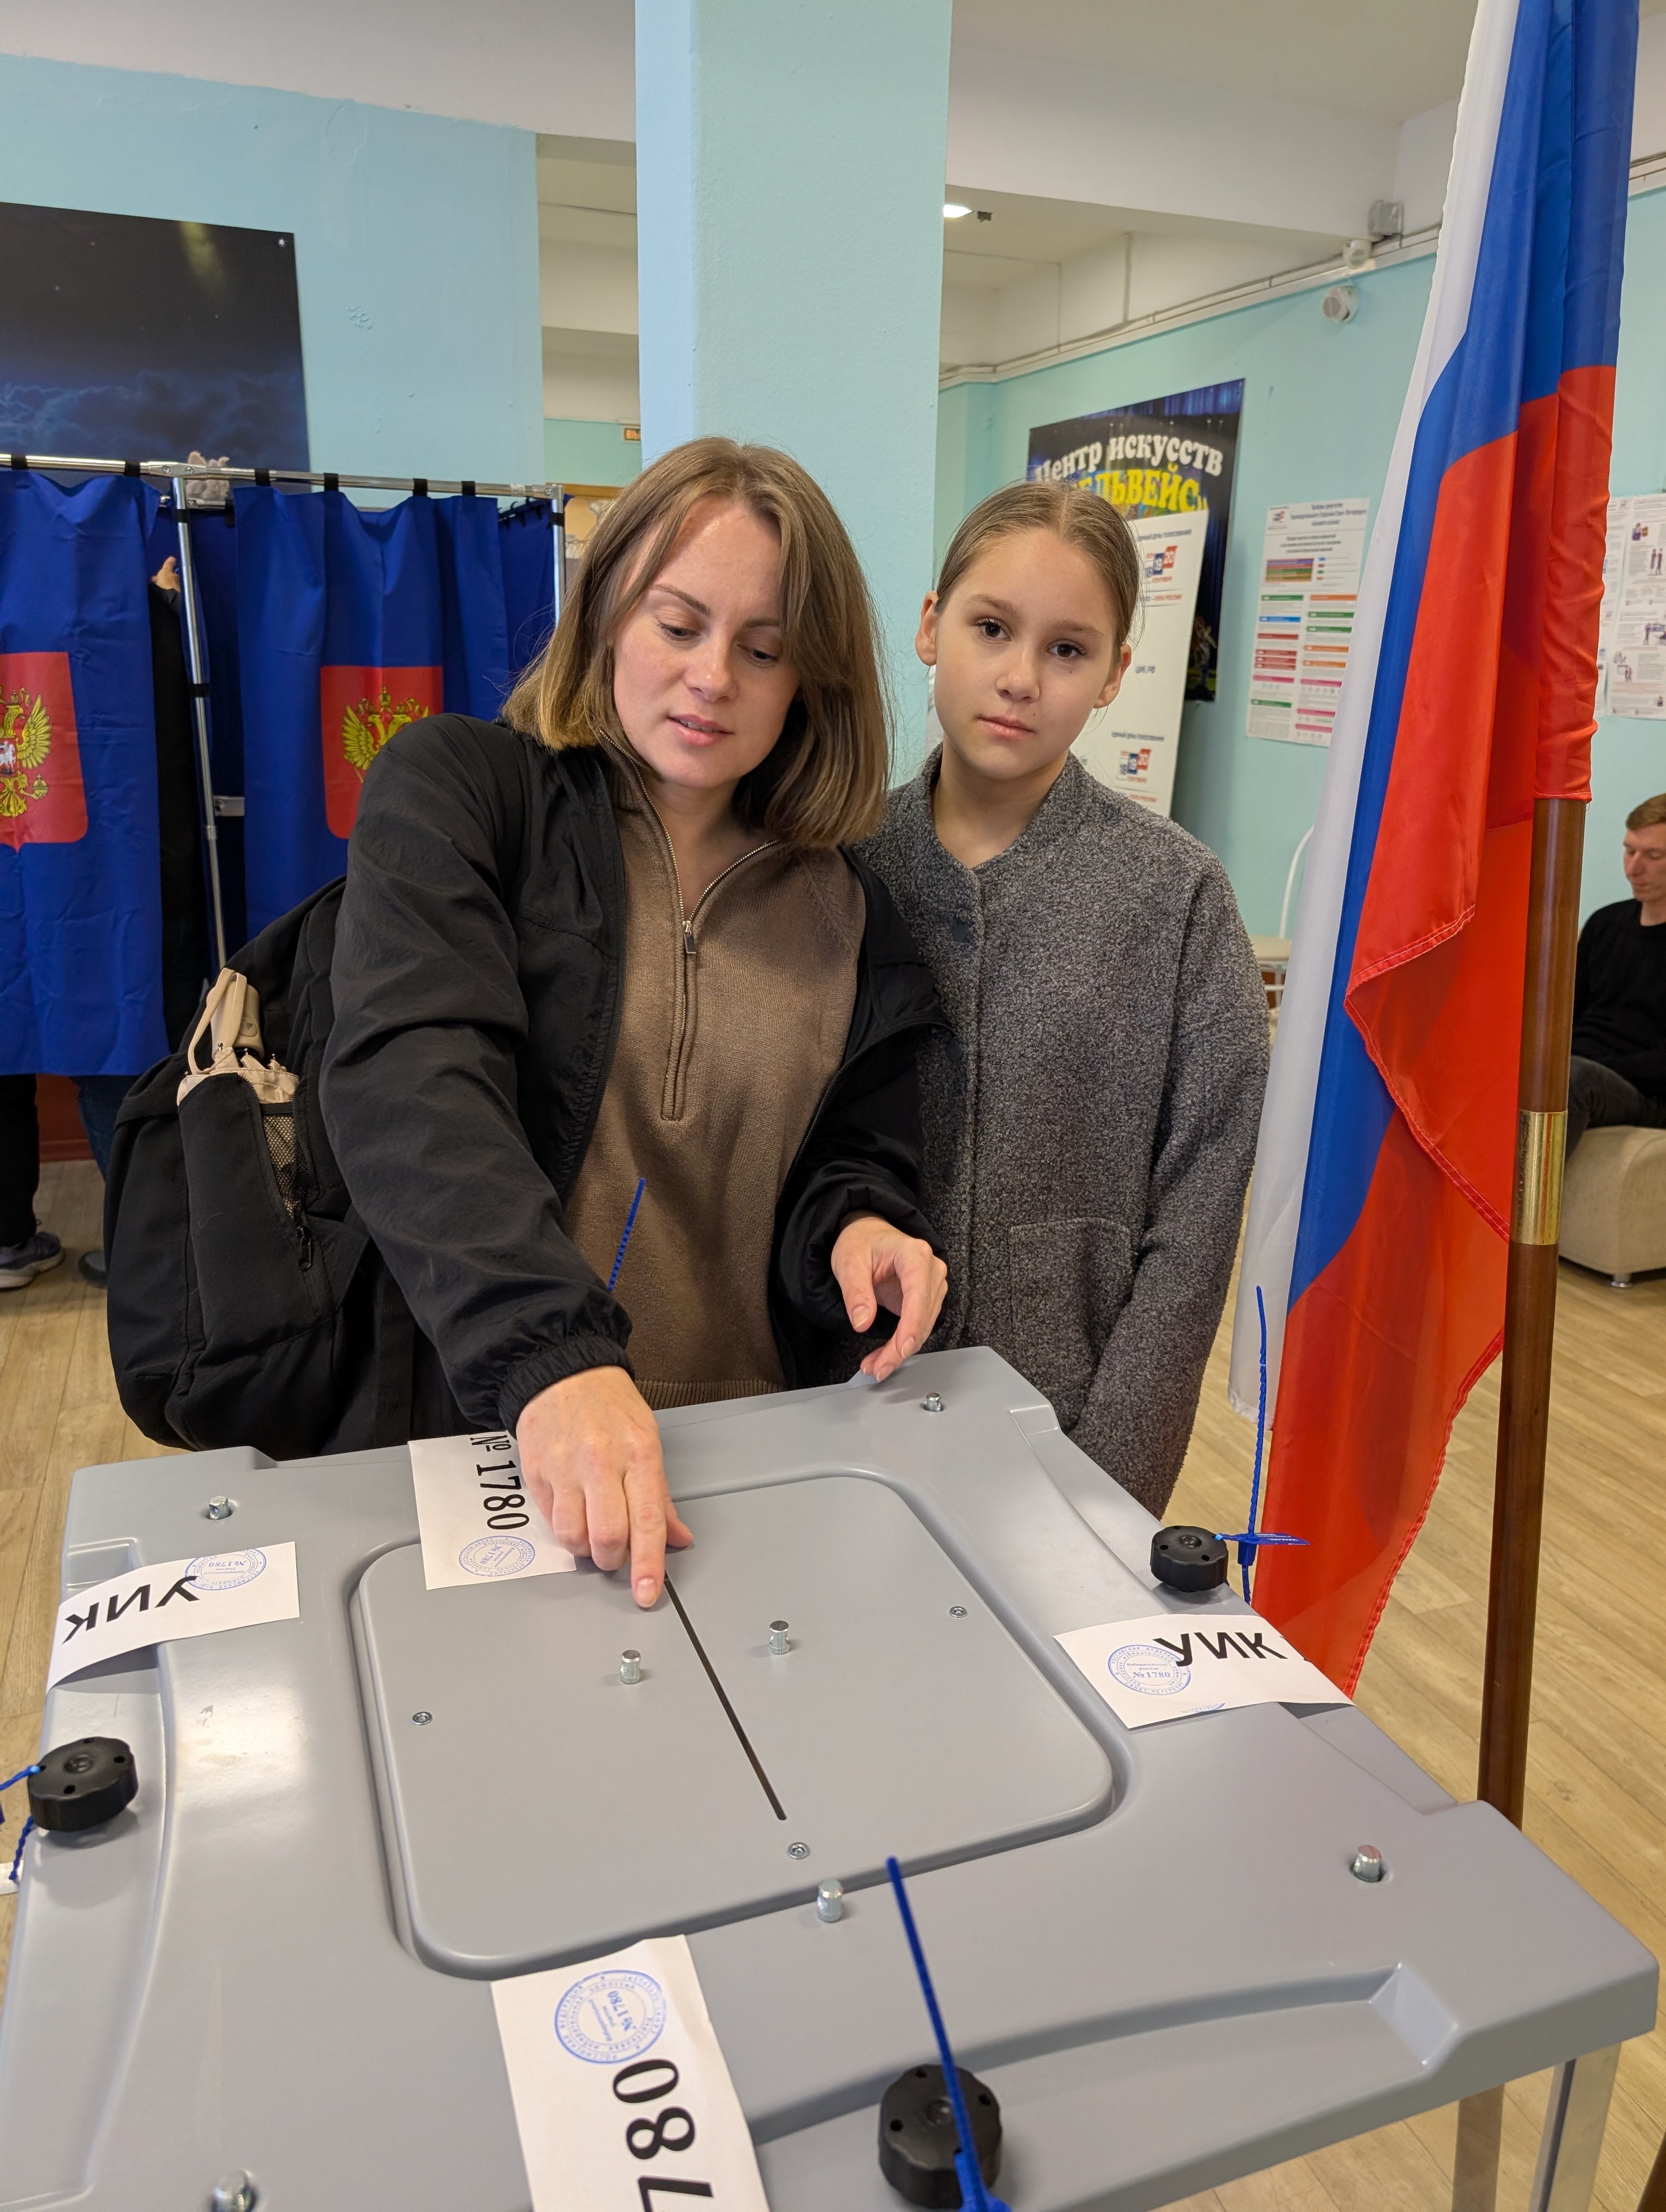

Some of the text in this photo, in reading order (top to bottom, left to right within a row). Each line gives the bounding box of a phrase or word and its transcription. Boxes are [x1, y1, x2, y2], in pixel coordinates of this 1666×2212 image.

[1034, 434, 1223, 481] Центр искусств
[1164, 550, 1174, 564] 20
[470, 1435, 530, 1529] № 1780
[62, 1576, 200, 1645] УИК
[1112, 1647, 1140, 1664] РОССИЙСКАЯ
[1153, 1632, 1289, 1667] УИК
